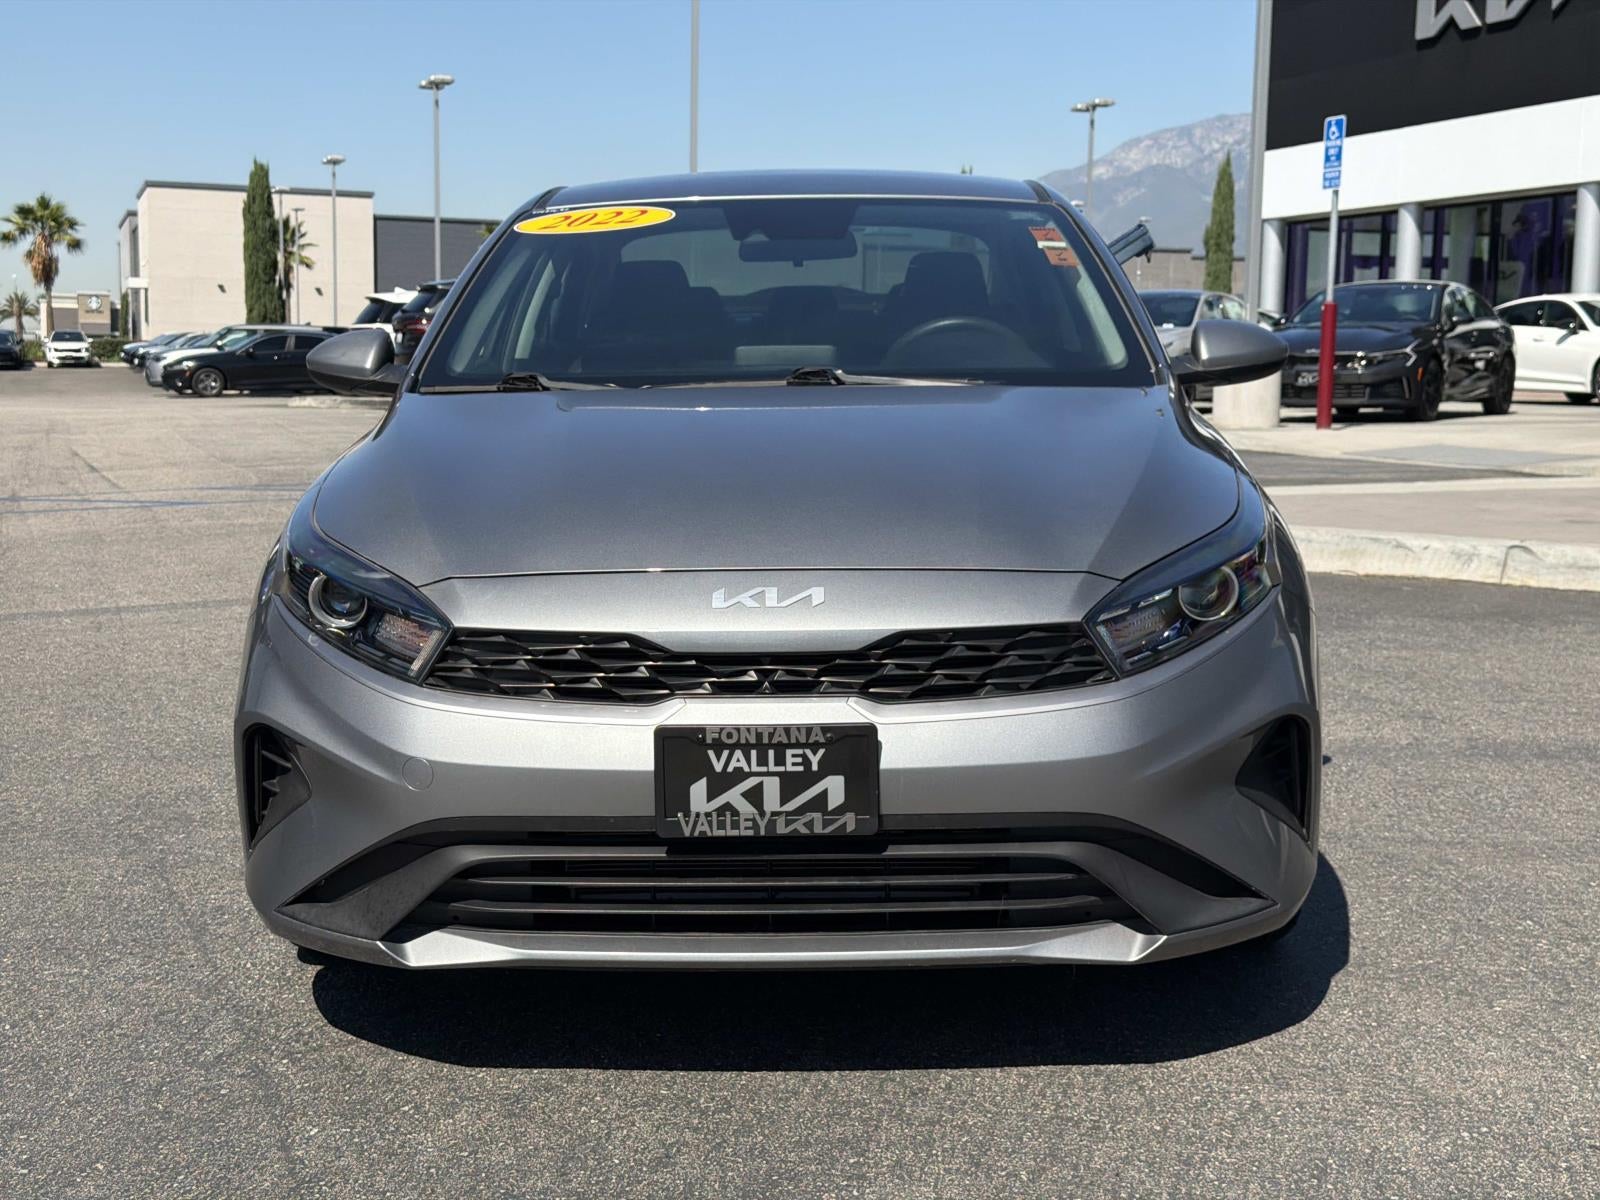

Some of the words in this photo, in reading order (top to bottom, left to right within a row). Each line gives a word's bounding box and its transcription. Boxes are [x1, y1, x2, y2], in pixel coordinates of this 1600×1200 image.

[538, 209, 648, 230] 2022
[712, 587, 825, 608] KIA
[705, 727, 825, 744] FONTANA
[707, 749, 826, 772] VALLEY
[690, 775, 845, 812] KIA
[678, 812, 771, 837] VALLEY
[776, 812, 856, 834] KIA
